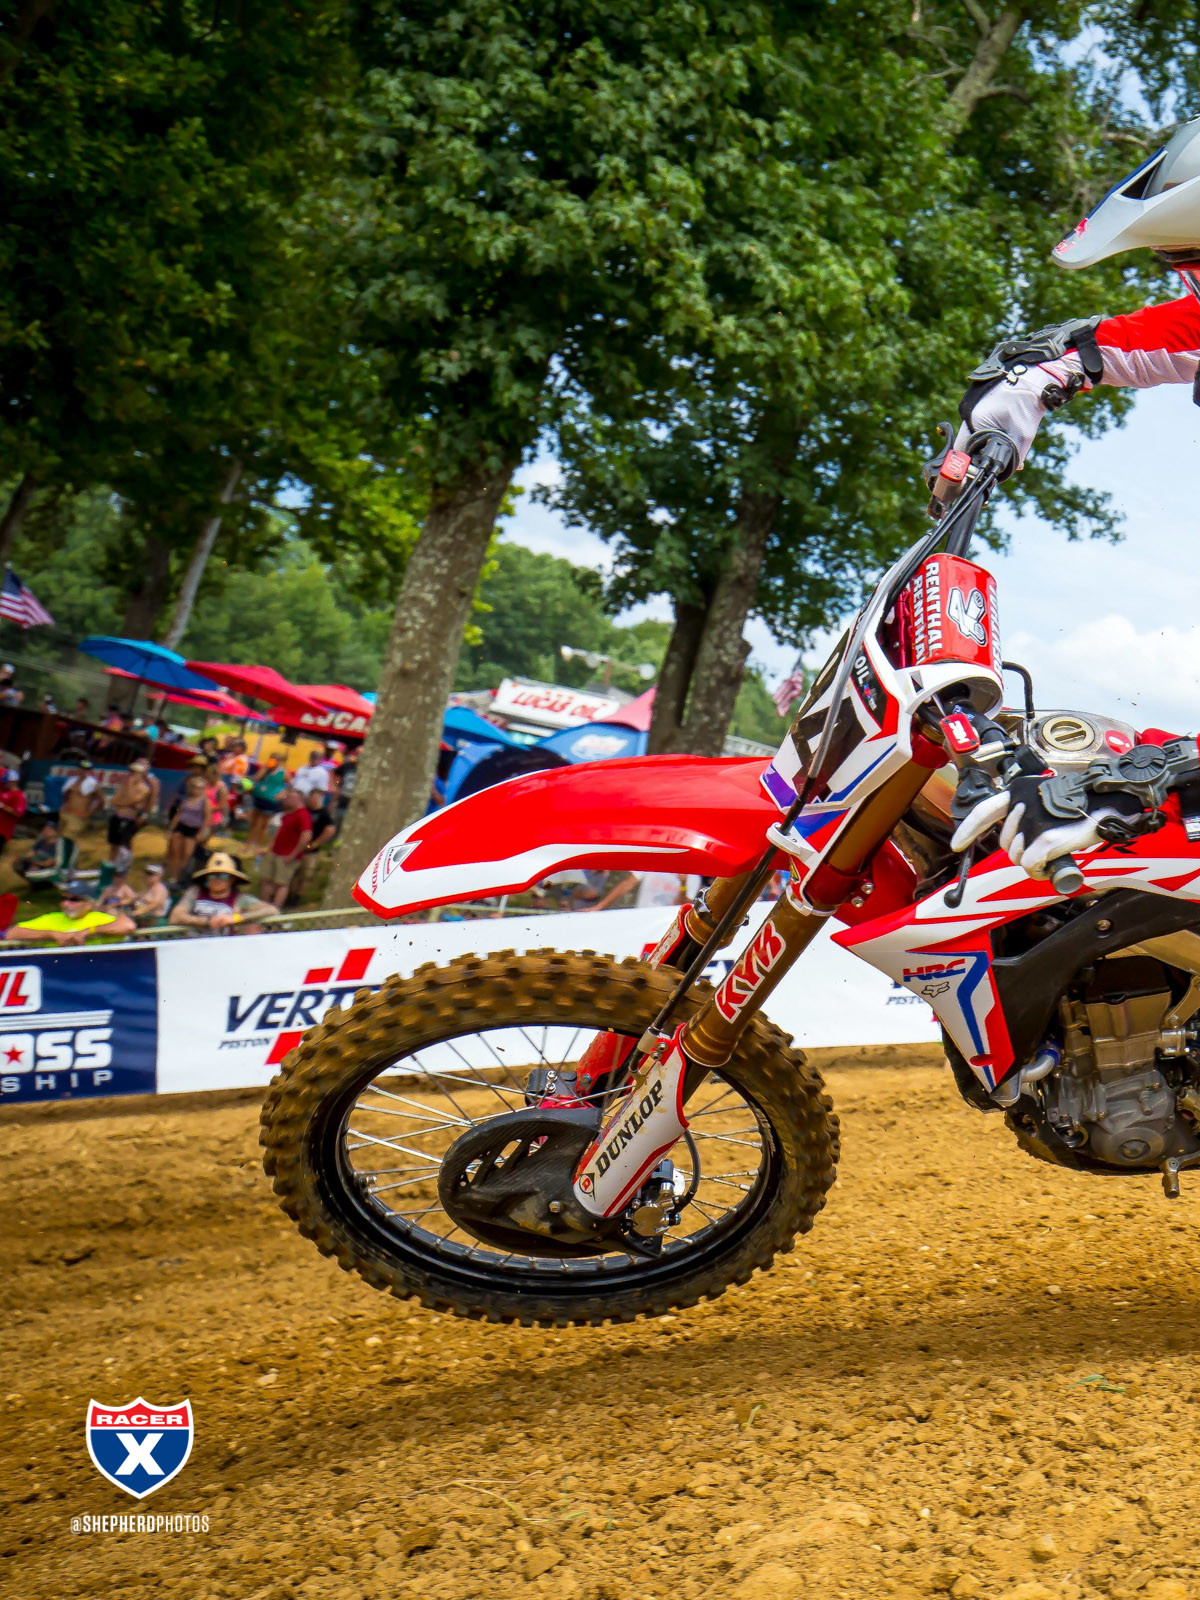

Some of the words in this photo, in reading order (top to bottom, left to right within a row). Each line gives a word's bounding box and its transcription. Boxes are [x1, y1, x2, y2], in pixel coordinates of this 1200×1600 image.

[925, 562, 943, 657] RENTHAL
[854, 655, 874, 686] OIL
[714, 920, 786, 1023] KYB
[903, 958, 966, 982] HRC
[226, 985, 384, 1033] VERT
[0, 1070, 113, 1092] SHIP
[595, 1079, 664, 1177] DUNLOP
